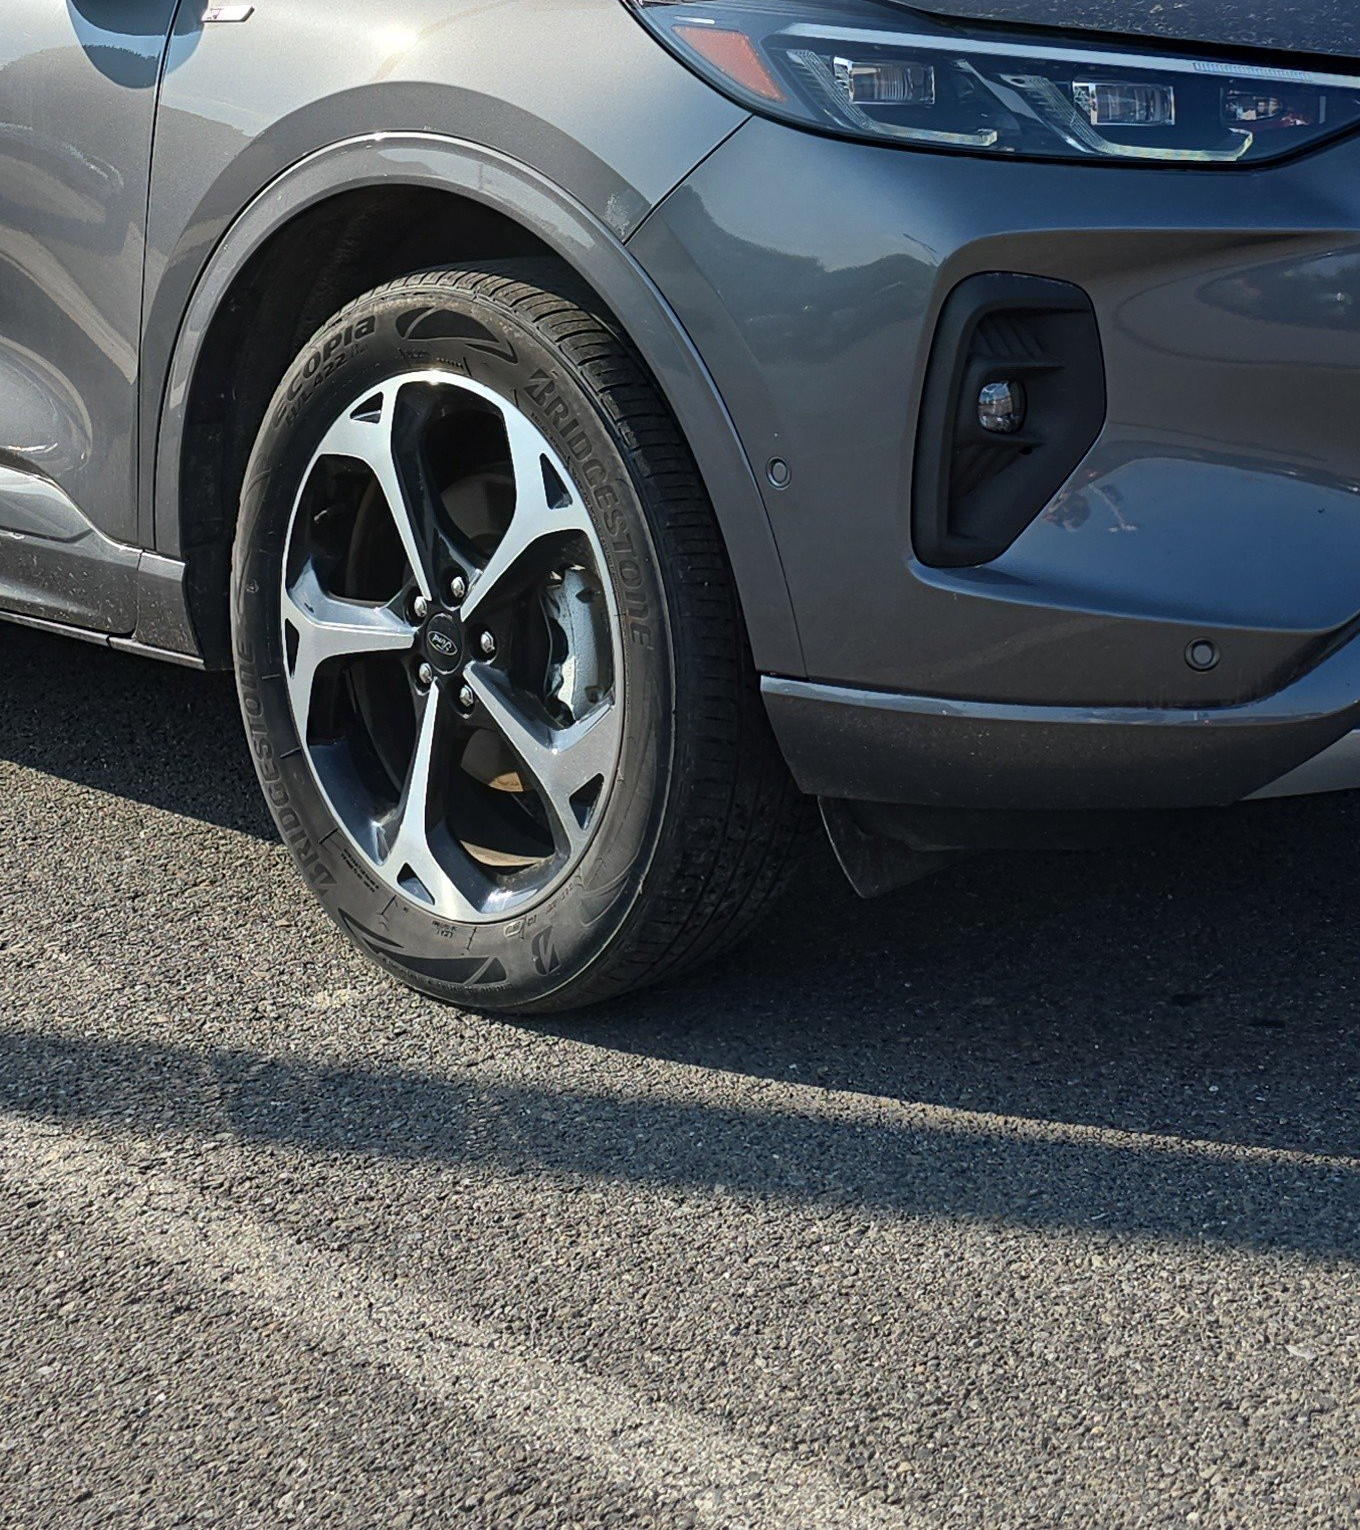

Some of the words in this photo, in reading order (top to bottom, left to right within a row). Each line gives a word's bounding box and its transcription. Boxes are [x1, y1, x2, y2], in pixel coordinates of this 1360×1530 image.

[313, 353, 348, 387] 422
[524, 369, 652, 650] BRIDGESTONE
[237, 627, 337, 898] BRIDGESTONE
